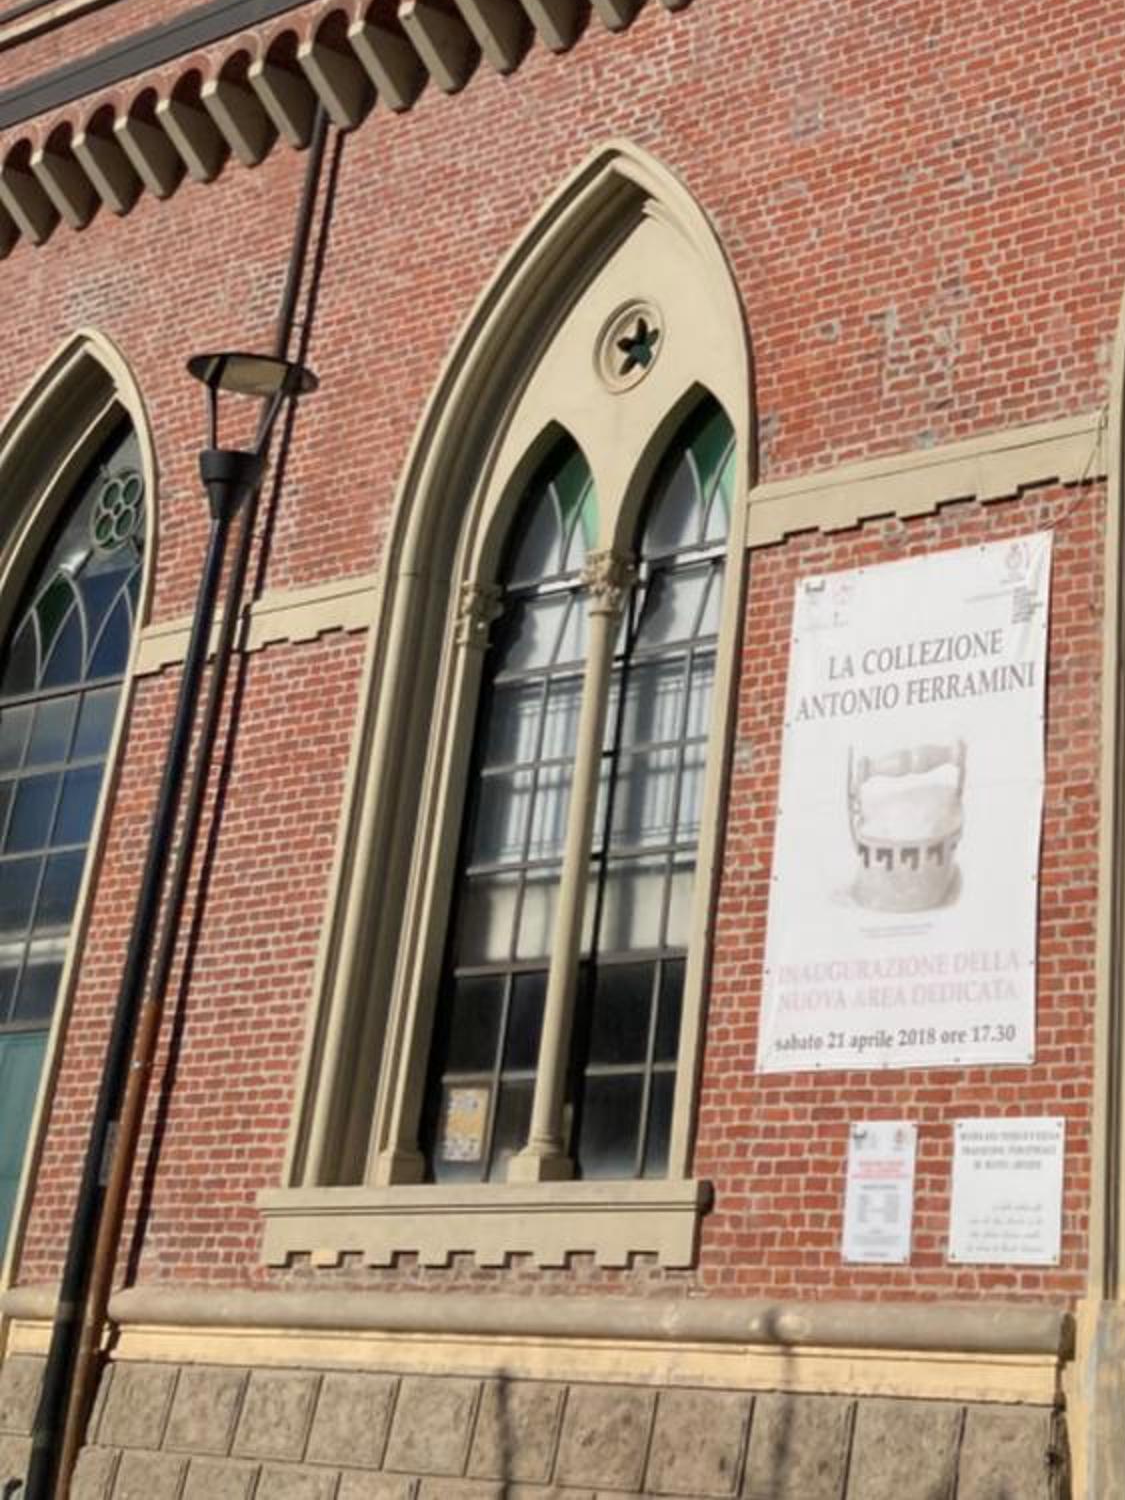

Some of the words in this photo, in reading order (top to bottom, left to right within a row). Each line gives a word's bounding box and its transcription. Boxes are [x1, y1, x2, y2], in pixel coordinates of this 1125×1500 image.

[827, 654, 855, 681] LA
[861, 627, 1004, 675] COLLEZIONE
[794, 682, 900, 723] ANTONIO
[904, 661, 1037, 707] FERRAMINI
[776, 953, 948, 985] INAUGURAZIONE
[952, 948, 1021, 973] DELLA
[777, 986, 848, 1013] NUOVA
[850, 983, 908, 1008] AREA
[910, 978, 1020, 1006] DEDICATA
[774, 1031, 822, 1053] sabato
[827, 1031, 845, 1050] 21
[848, 1028, 894, 1055] aprile
[896, 1026, 937, 1046] 2018
[939, 1029, 968, 1044] ore
[971, 1023, 1017, 1043] 17.30
